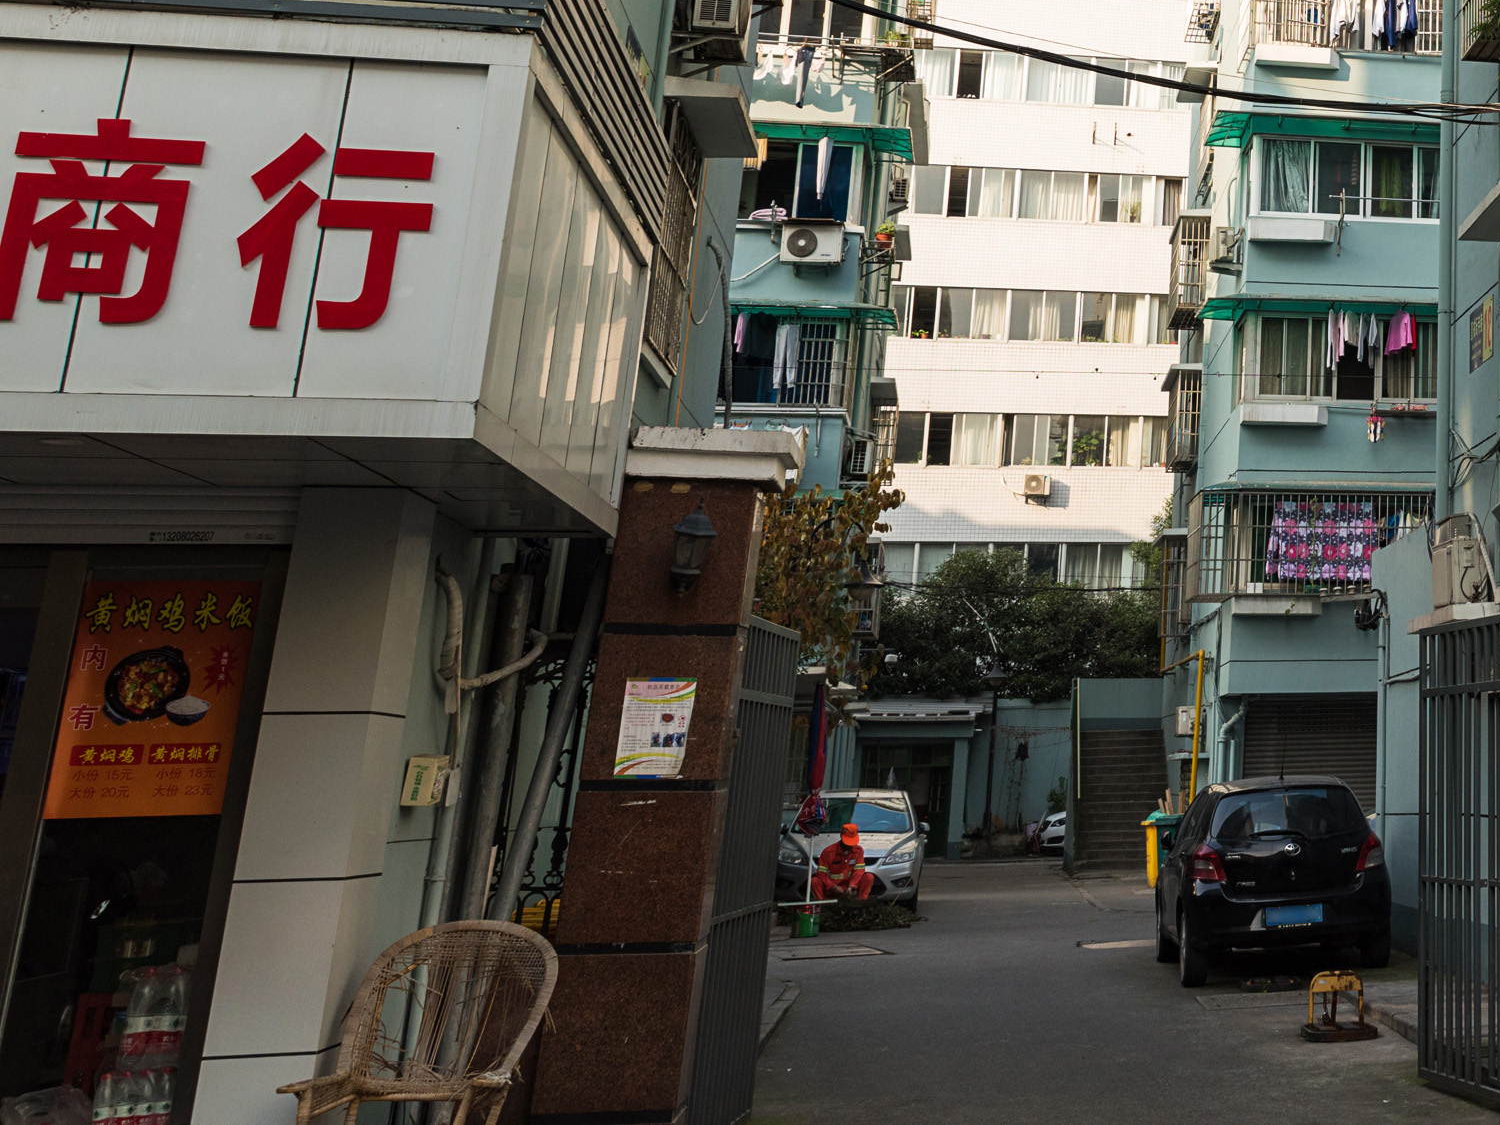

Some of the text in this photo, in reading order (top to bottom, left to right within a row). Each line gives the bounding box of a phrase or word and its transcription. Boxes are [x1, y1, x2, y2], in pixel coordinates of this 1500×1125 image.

[0, 118, 436, 330] 商行
[85, 591, 254, 634] 黄焖鸡米饭
[79, 746, 135, 765] 黄焖鸡
[150, 744, 220, 763] 黄焖排骨
[72, 769, 133, 782] 小份 15元
[155, 766, 216, 780] 小份 18元
[68, 786, 130, 800] 大份 20元
[152, 784, 213, 798] 大份 23元
